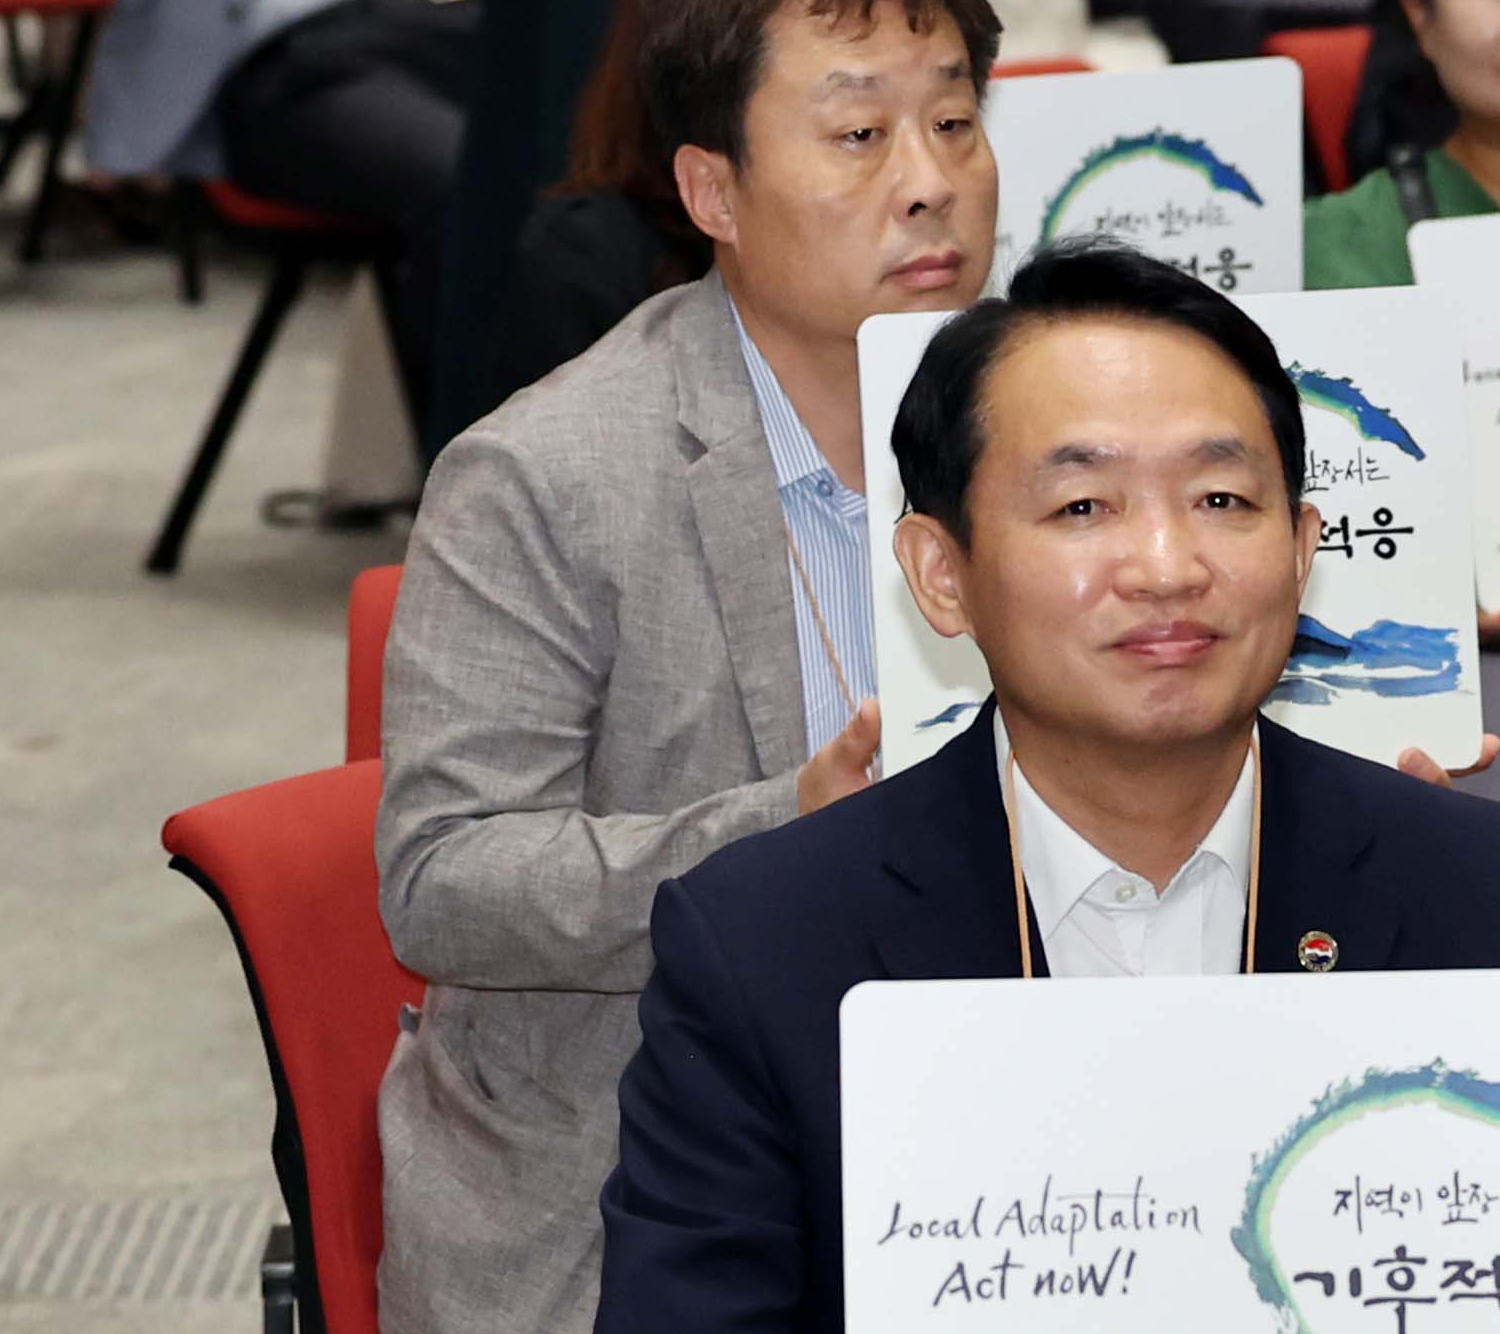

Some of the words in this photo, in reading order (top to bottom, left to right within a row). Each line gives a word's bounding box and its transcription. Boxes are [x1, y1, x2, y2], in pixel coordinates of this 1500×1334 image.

[877, 1199, 982, 1246] Local
[995, 1174, 1202, 1255] Adaptation
[1334, 1175, 1424, 1234] 지역이
[933, 1251, 1025, 1307] Act
